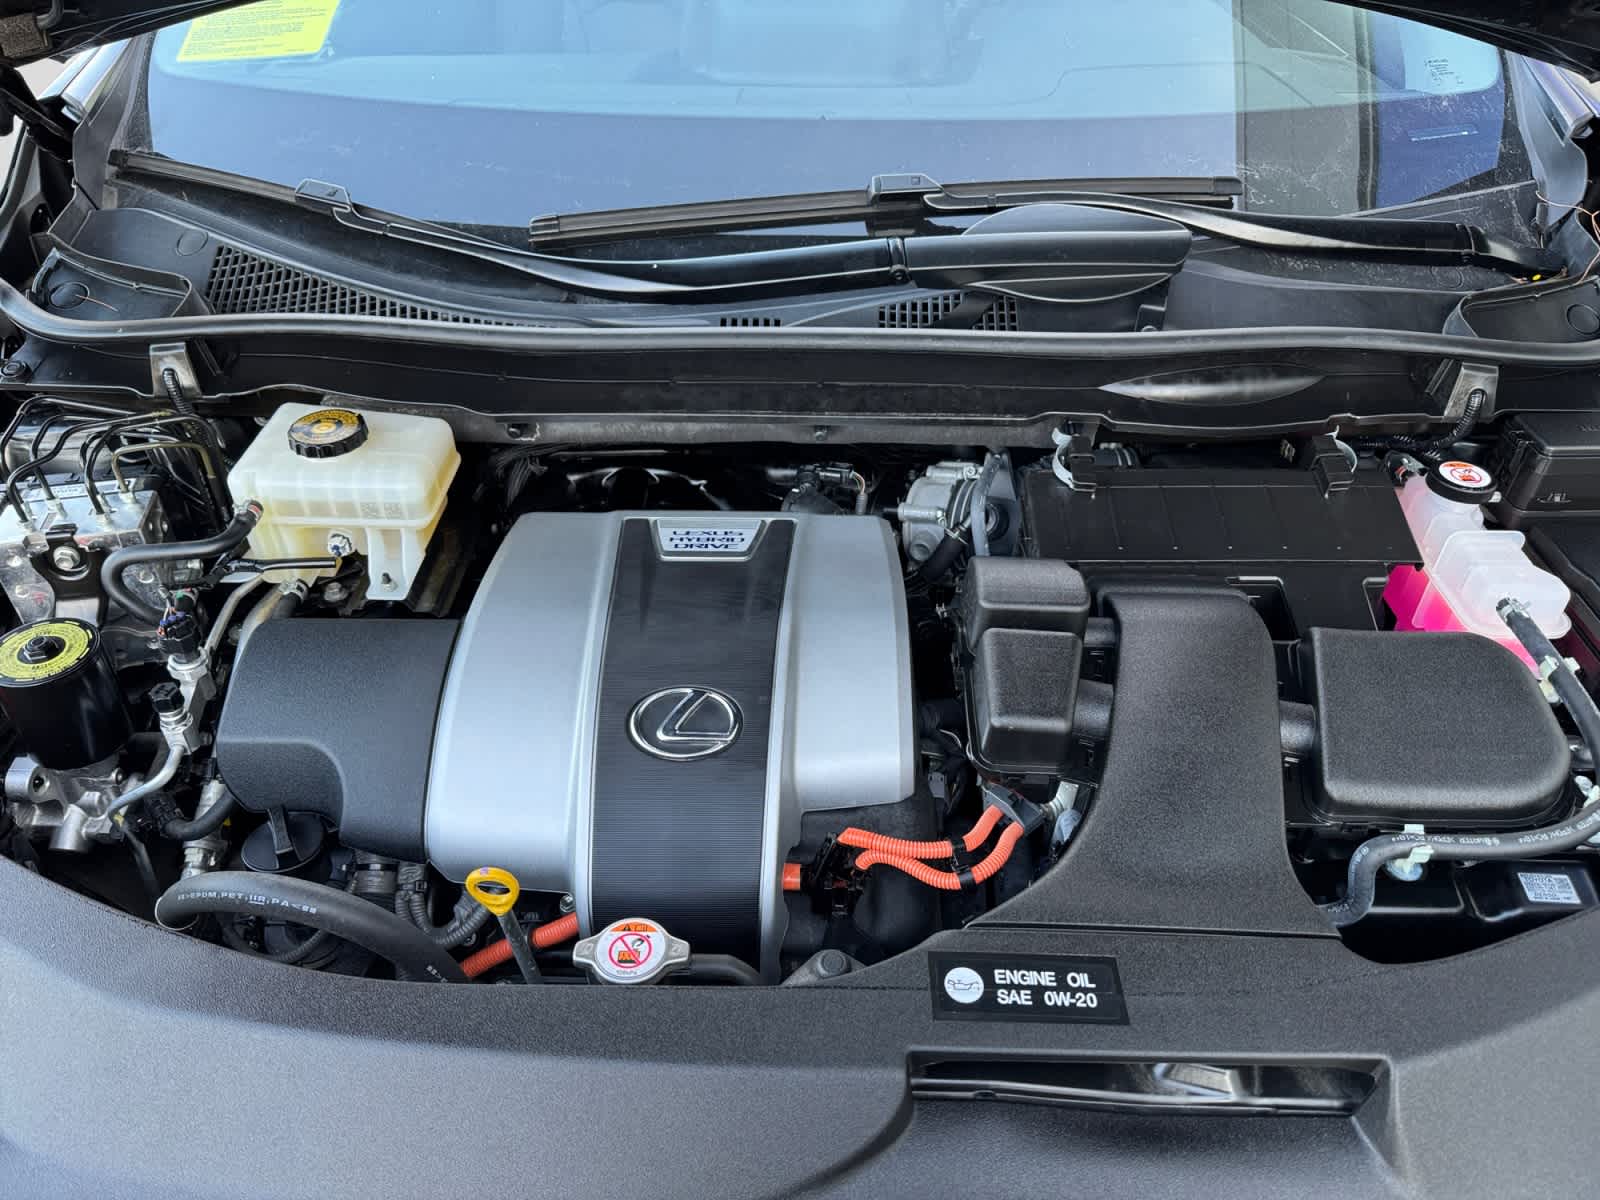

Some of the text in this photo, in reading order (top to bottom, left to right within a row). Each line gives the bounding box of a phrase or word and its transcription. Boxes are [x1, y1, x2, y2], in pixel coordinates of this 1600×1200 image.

[993, 968, 1097, 988] ENGINE OIL
[997, 988, 1098, 1008] SAE 0W-20
